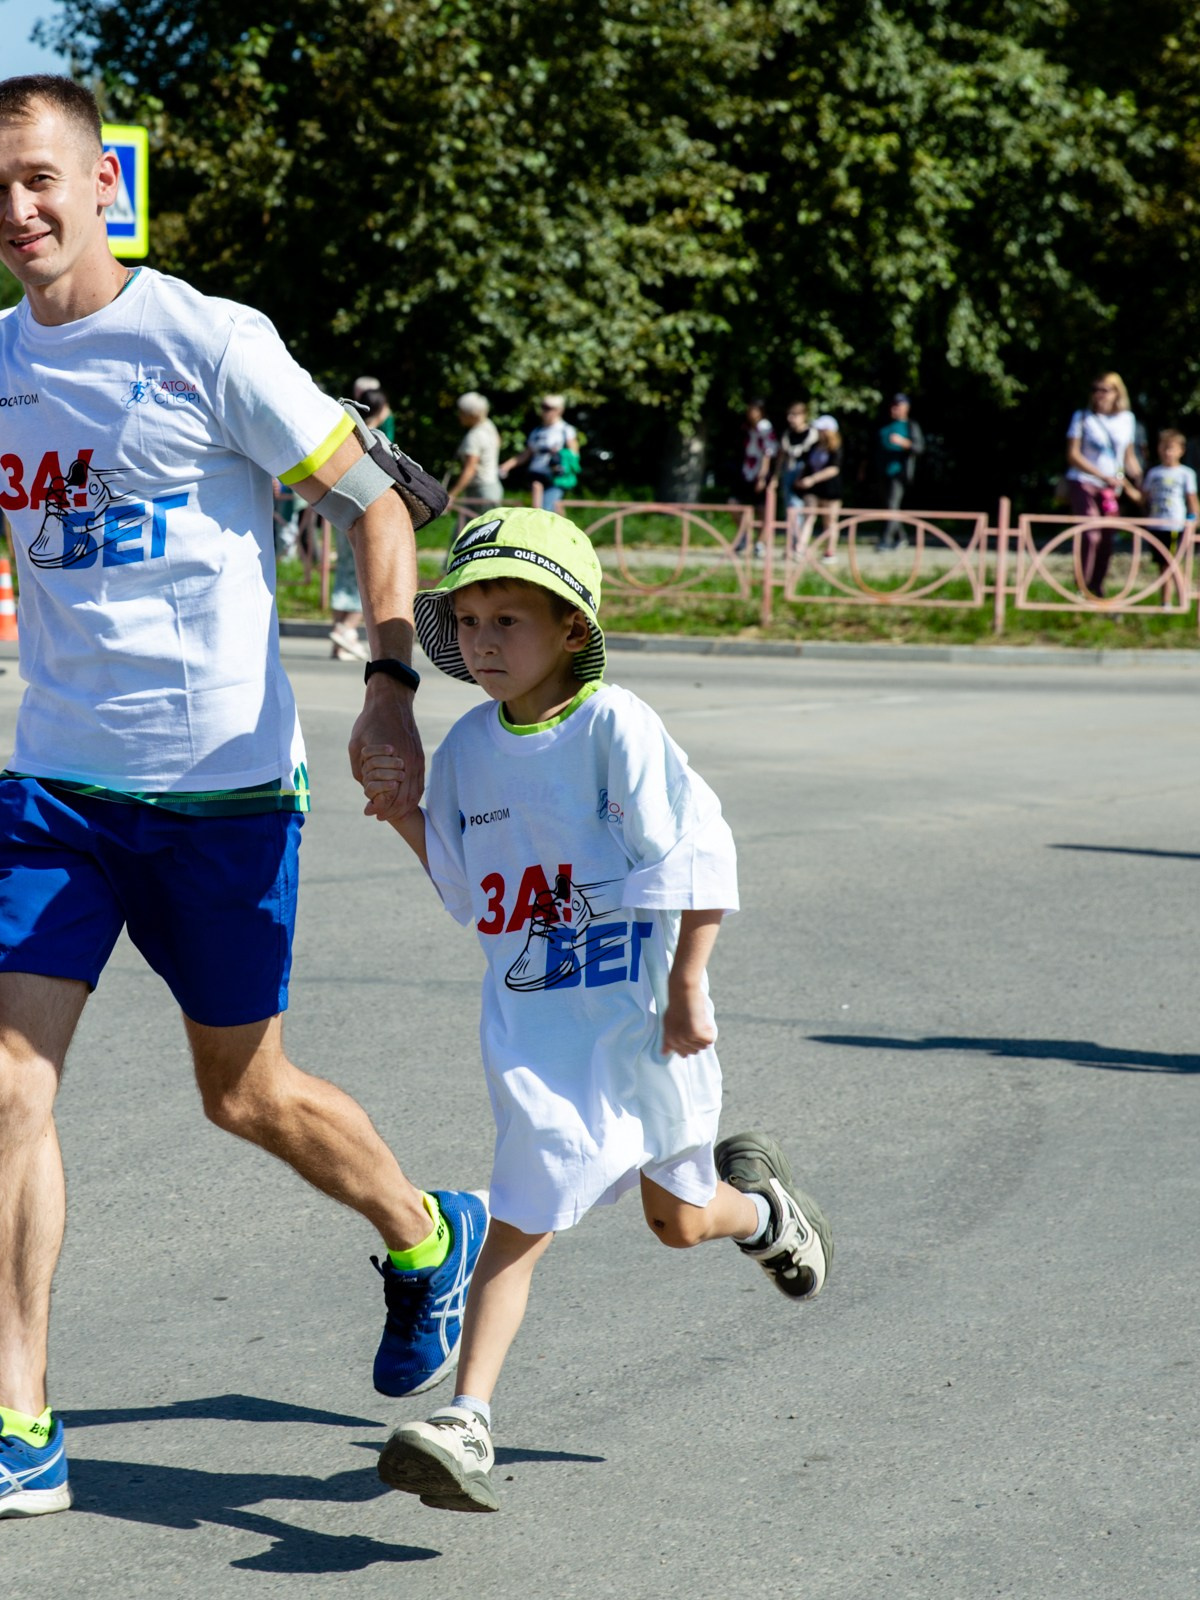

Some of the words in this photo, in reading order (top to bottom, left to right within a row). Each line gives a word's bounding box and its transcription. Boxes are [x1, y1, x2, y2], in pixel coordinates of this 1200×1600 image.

[154, 391, 200, 405] СПОРТ
[160, 380, 197, 392] АТОМ
[62, 492, 189, 570] БЕГ
[473, 548, 500, 560] BRO?
[537, 556, 565, 579] PASA,
[563, 572, 584, 595] BRO?
[470, 808, 510, 826] РОСАТОМ
[477, 863, 573, 935] ЗА!
[544, 921, 653, 990] БЕГ
